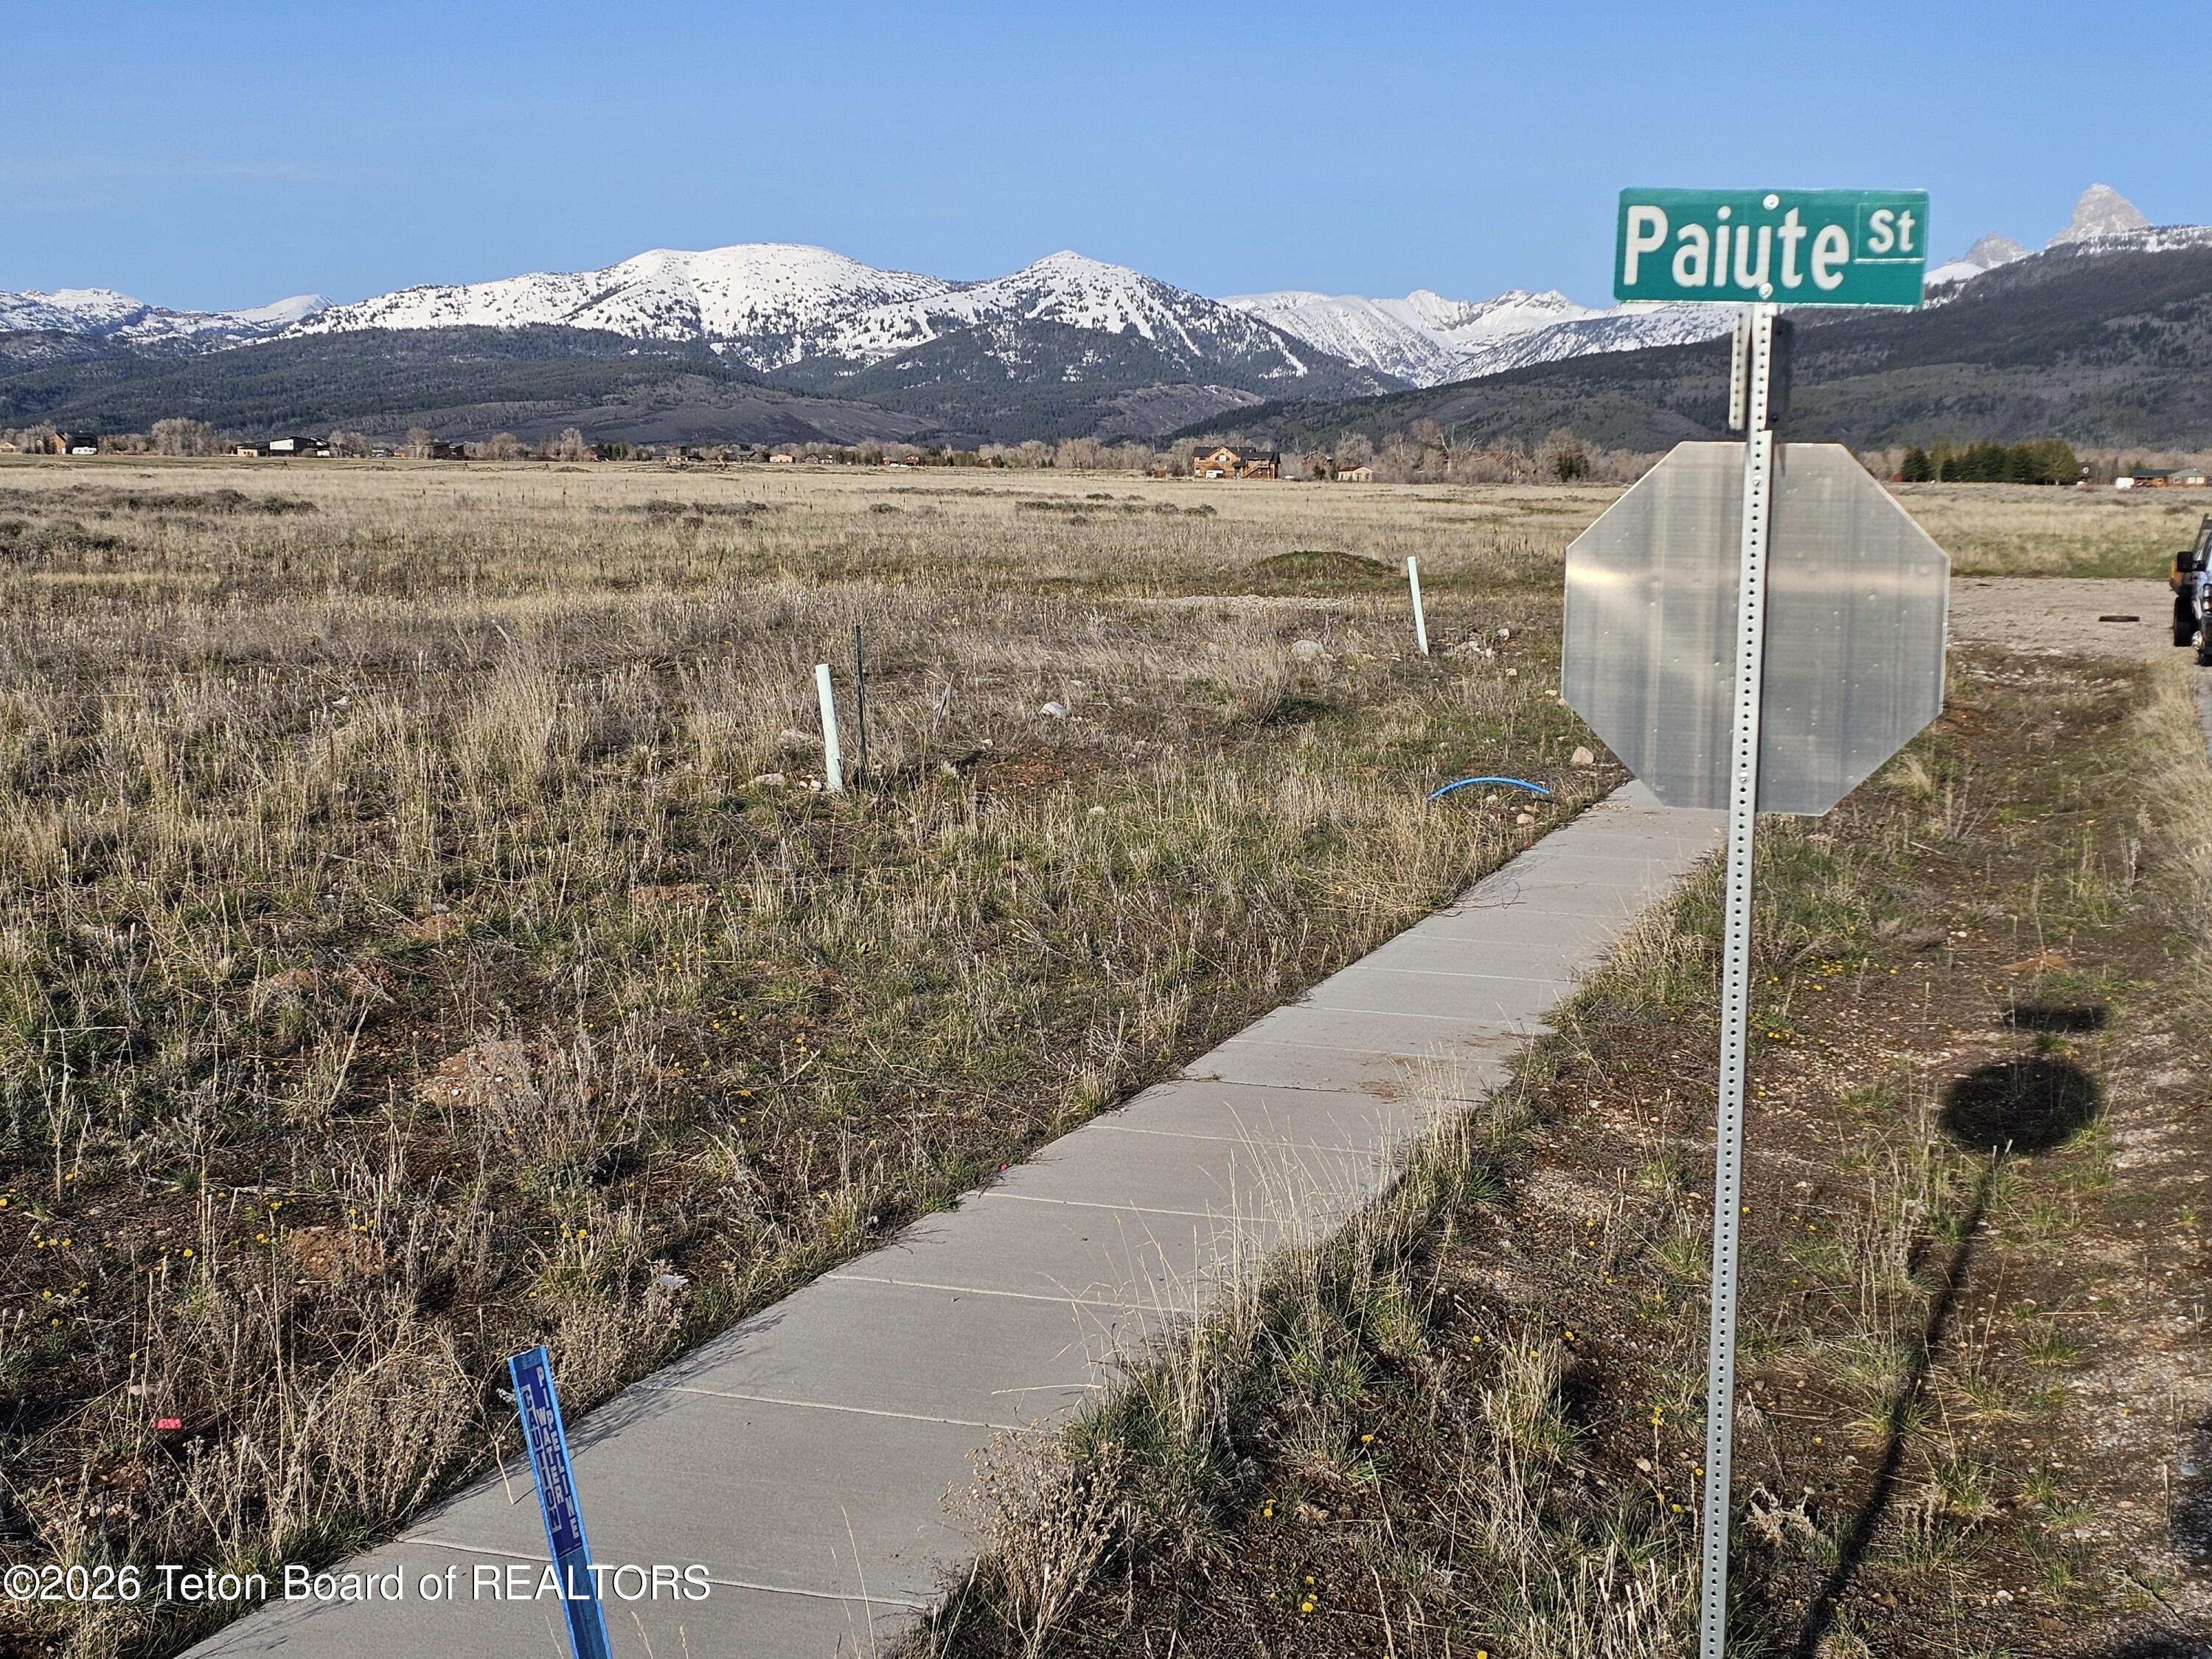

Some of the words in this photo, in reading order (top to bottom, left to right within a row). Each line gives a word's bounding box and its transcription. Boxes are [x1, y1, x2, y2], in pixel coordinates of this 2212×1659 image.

[1623, 205, 1850, 291] Paiute
[1868, 209, 1916, 254] St
[522, 1390, 560, 1529] CAUTION
[536, 1366, 580, 1540] PIPELINE
[536, 1407, 565, 1505] WATER
